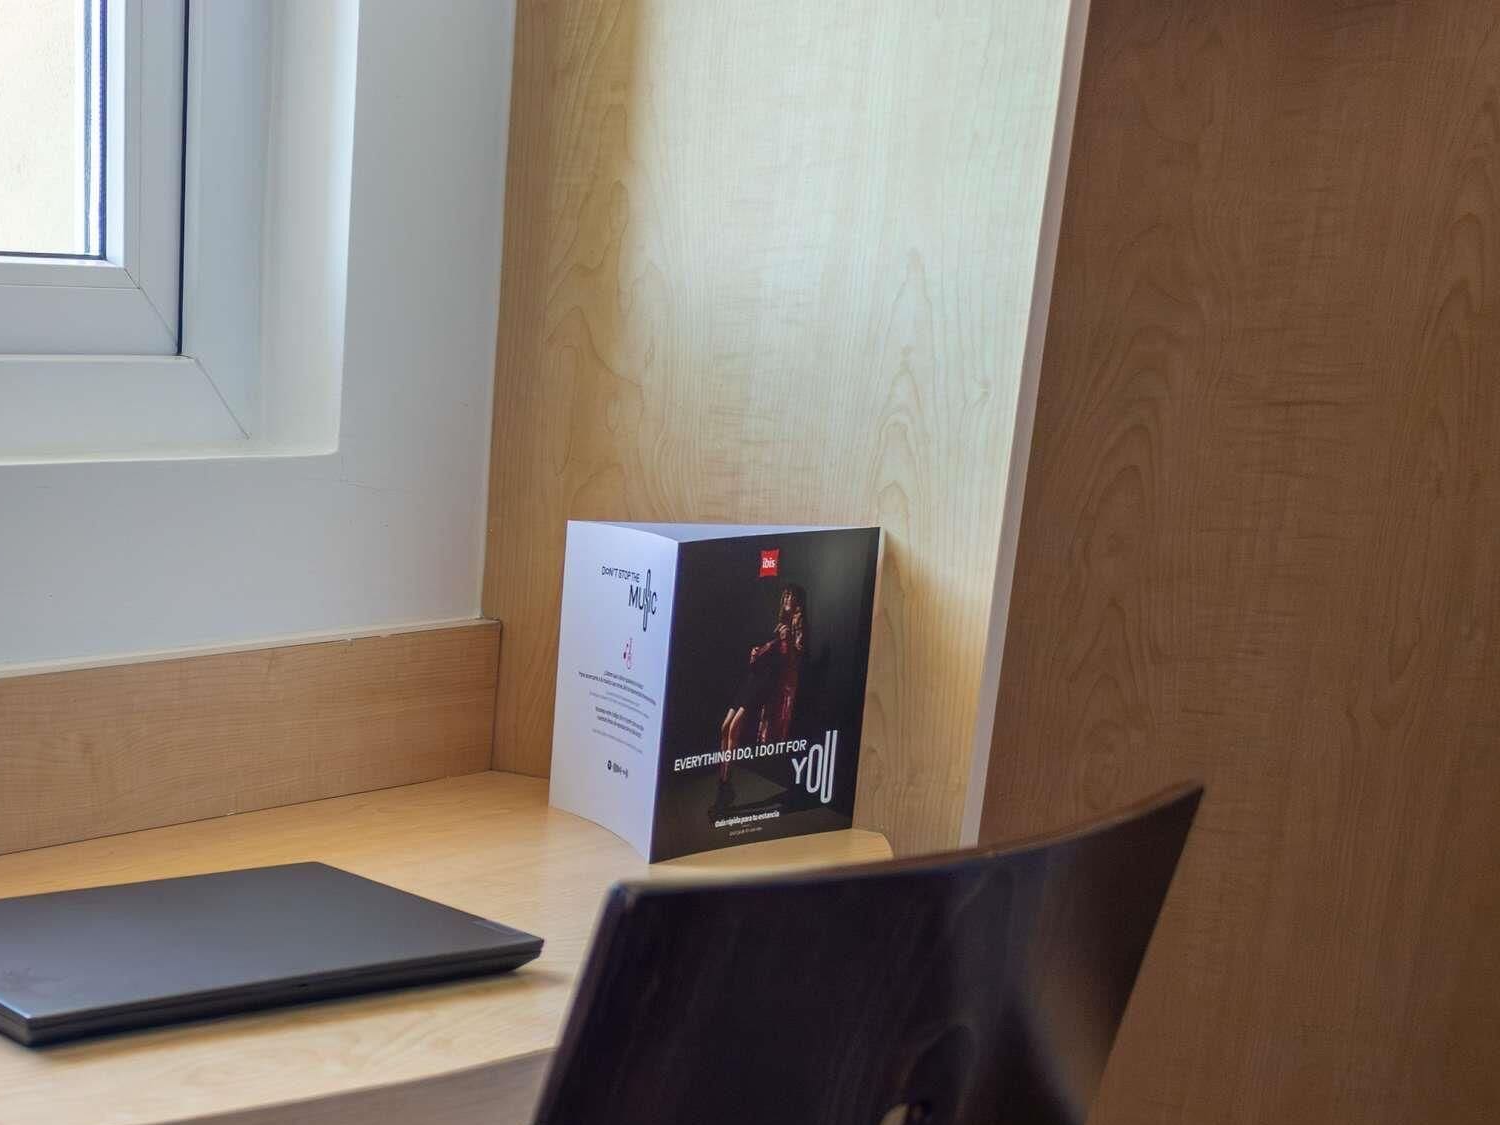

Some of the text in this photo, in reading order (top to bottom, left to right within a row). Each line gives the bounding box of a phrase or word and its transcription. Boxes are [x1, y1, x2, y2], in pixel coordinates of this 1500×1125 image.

[601, 565, 640, 583] DON'T STOP THE
[762, 557, 776, 568] ibis
[628, 568, 658, 632] MUSIC
[674, 750, 732, 771] EVERYTHING
[737, 747, 754, 759] DO,
[759, 743, 775, 757] DO
[775, 742, 785, 754] IT
[786, 739, 807, 753] FOR
[791, 730, 838, 804] YOU
[758, 809, 780, 820] estancia
